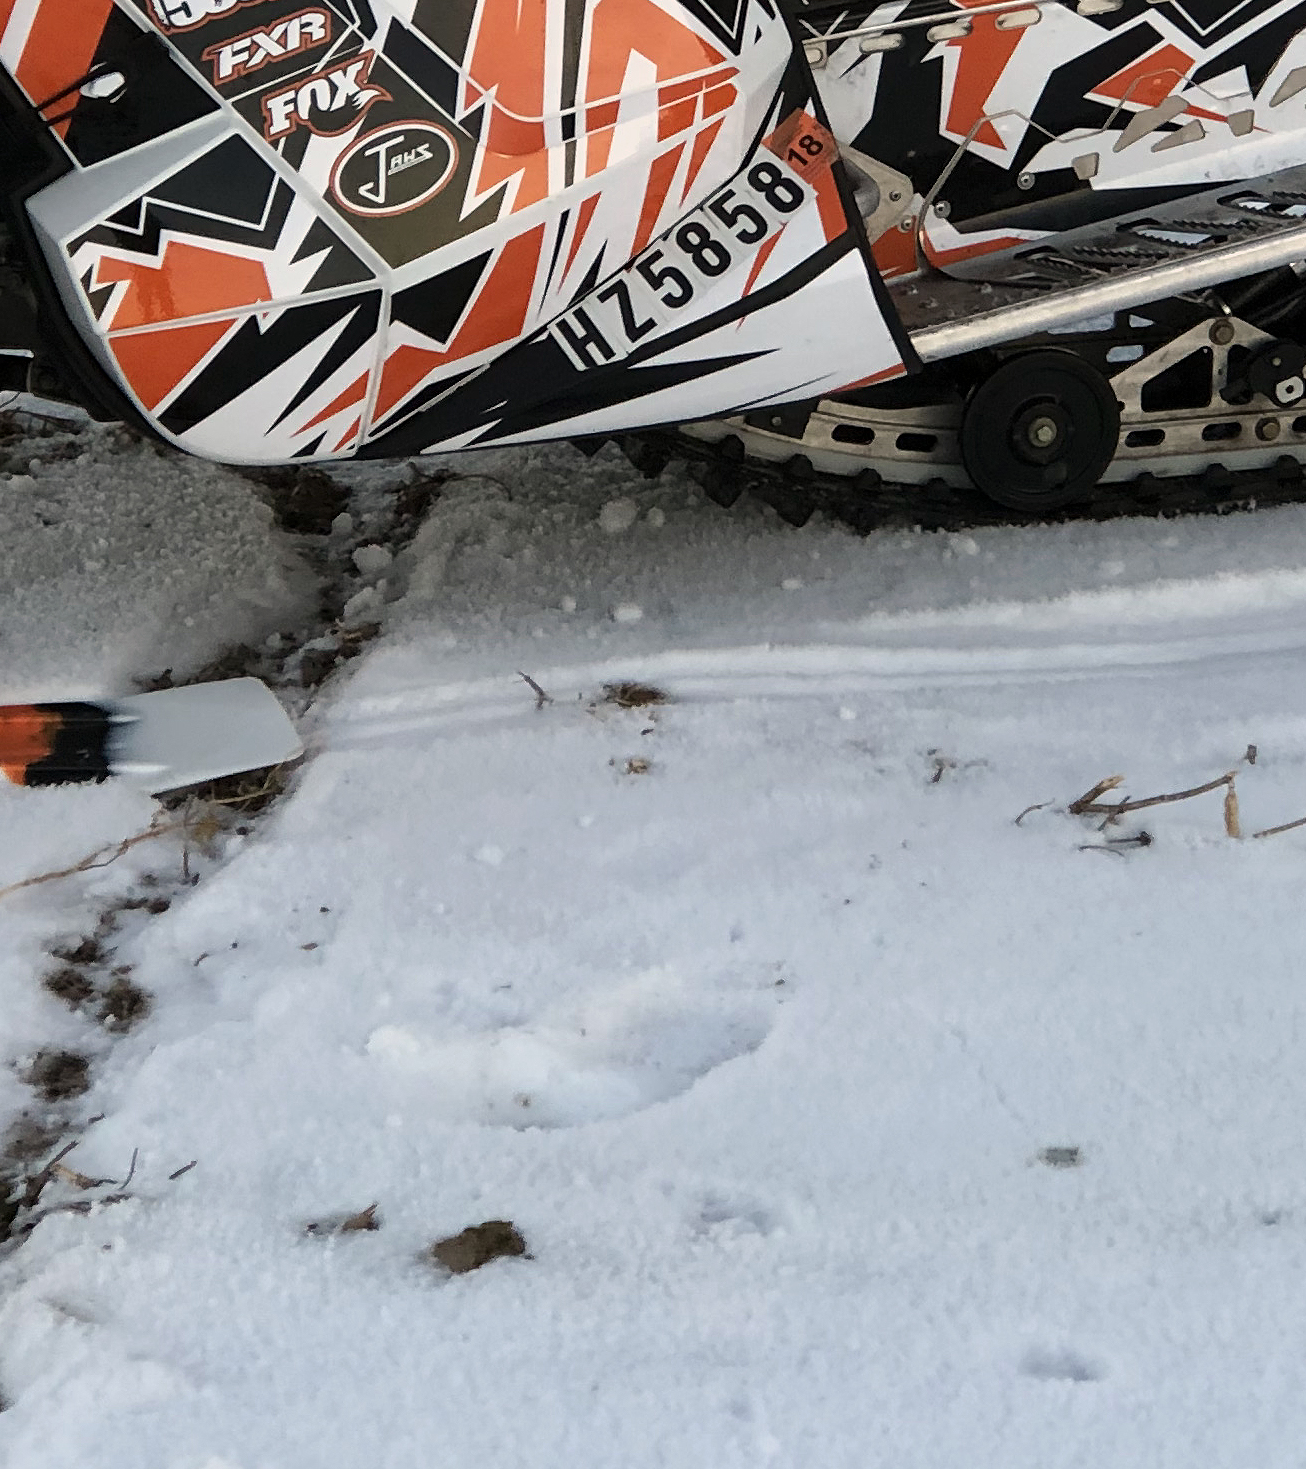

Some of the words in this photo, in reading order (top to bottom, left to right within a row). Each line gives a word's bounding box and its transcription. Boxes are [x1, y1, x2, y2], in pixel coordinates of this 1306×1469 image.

[213, 12, 326, 79] FXR
[267, 60, 382, 135] FOX
[787, 134, 824, 167] 18
[555, 162, 804, 367] HZ5858
